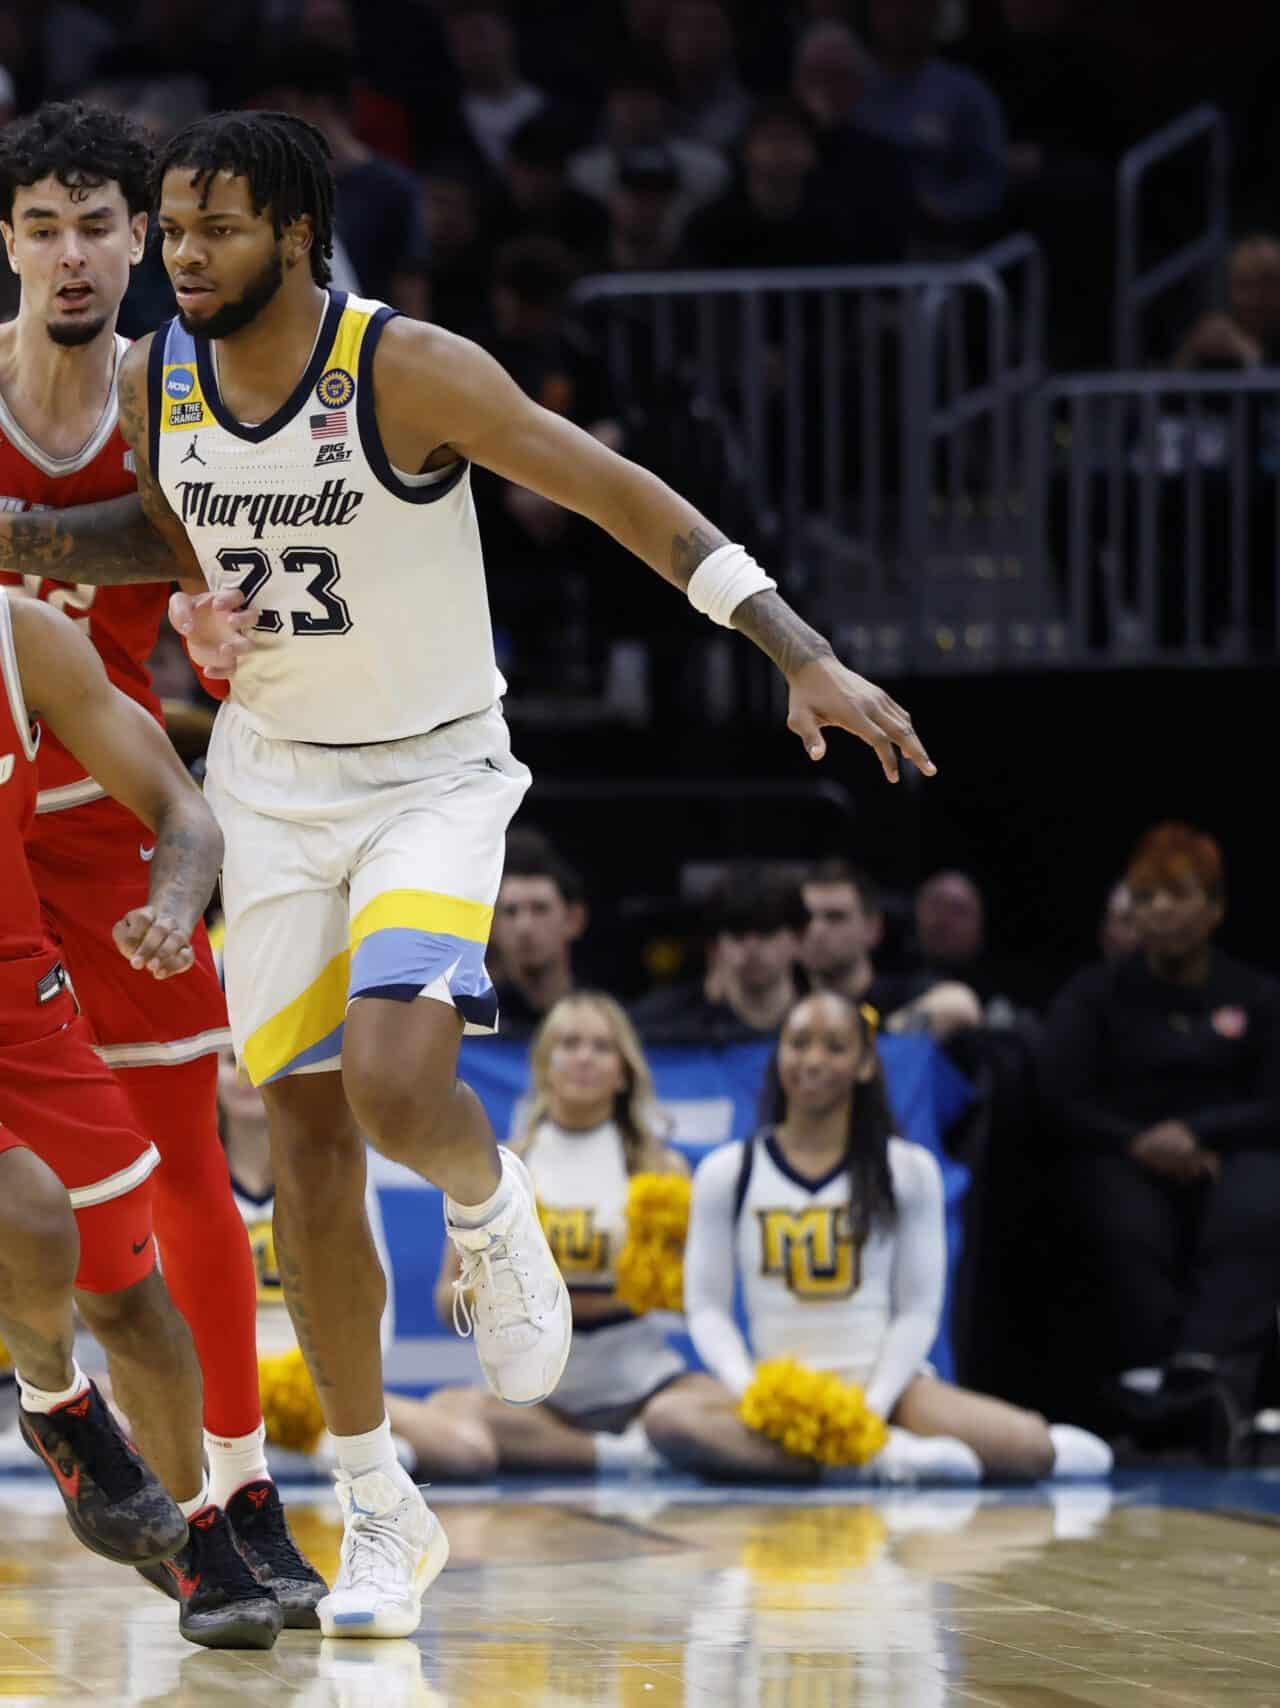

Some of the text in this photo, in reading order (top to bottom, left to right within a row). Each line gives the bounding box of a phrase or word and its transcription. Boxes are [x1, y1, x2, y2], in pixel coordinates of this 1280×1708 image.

[172, 402, 201, 416] BE THE
[170, 411, 202, 424] CHANGE
[320, 442, 345, 454] BIG
[316, 450, 352, 462] EAST
[175, 478, 364, 539] Marquette
[216, 547, 354, 636] 23
[756, 1204, 864, 1302] MU
